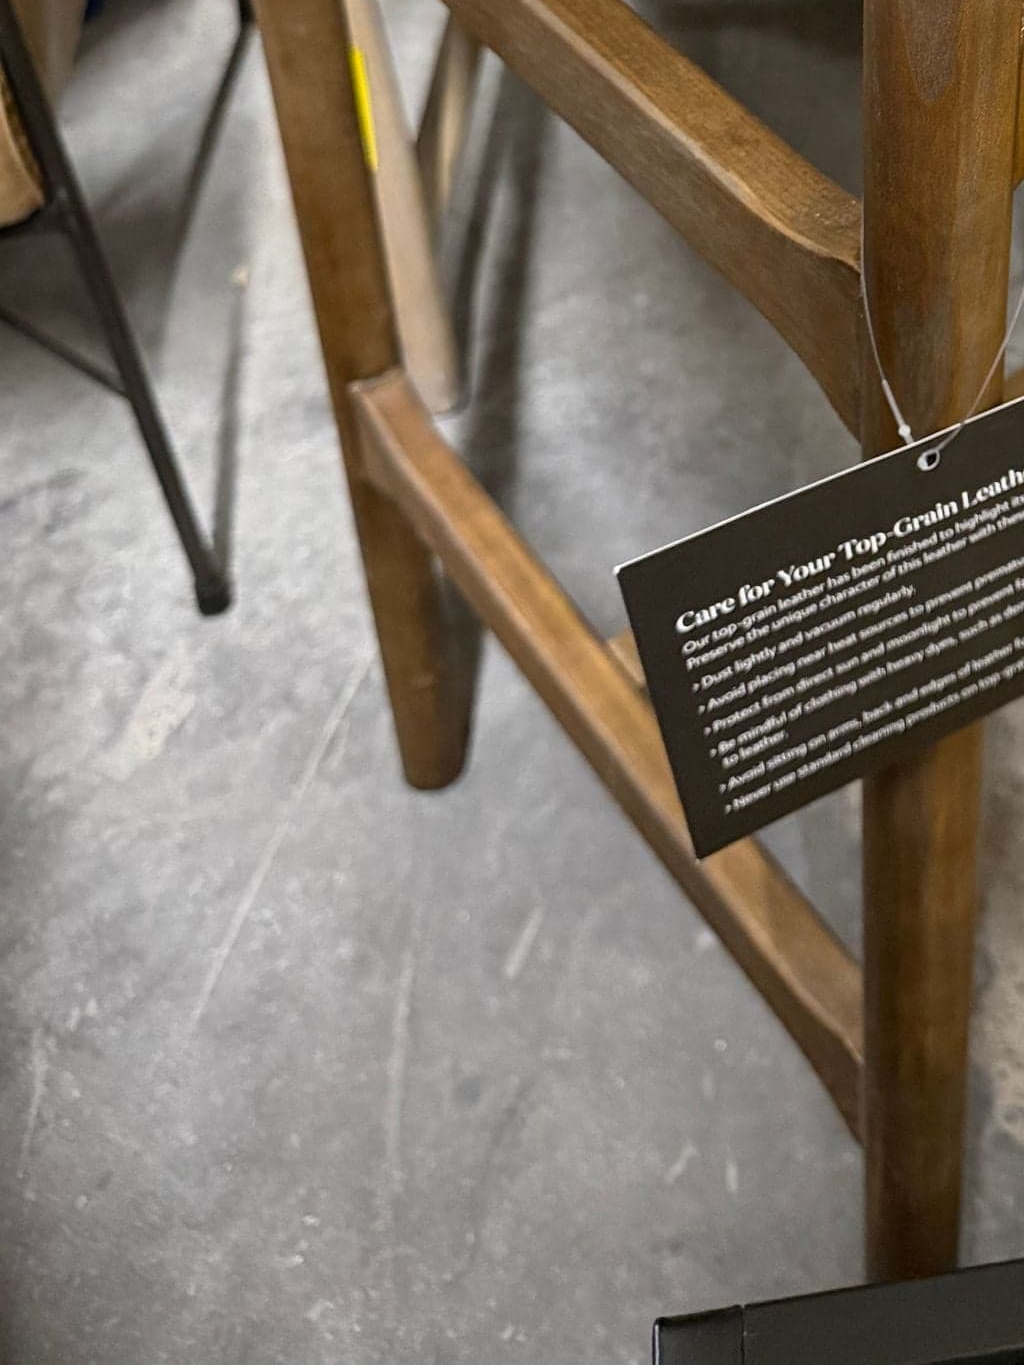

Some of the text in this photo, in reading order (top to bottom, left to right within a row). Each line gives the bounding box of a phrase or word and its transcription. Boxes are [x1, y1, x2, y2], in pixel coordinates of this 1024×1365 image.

[674, 596, 736, 633] Care
[737, 577, 776, 607] for
[776, 551, 836, 587] Your
[836, 500, 959, 560] Top-Grain
[681, 633, 710, 654] Our
[711, 604, 777, 641] top-grain
[776, 582, 825, 611] leather
[825, 571, 851, 589] has
[850, 556, 886, 579] been
[885, 531, 938, 563] finished
[937, 527, 955, 541] to
[953, 500, 1010, 533] highlight
[685, 635, 745, 670] Preserve
[744, 623, 770, 642] the
[770, 602, 818, 630] unique
[817, 574, 881, 610] character
[881, 564, 896, 582] of
[896, 556, 923, 575] this
[921, 535, 968, 564] leather
[967, 522, 997, 543] with
[700, 583, 918, 689] Dust lightly and vacuum regularly.
[706, 681, 747, 711] Avoid
[746, 660, 796, 693] placing
[795, 646, 826, 668] near
[826, 631, 858, 653] heat
[857, 610, 909, 640] sources
[907, 603, 925, 617] to
[924, 580, 973, 613] prevent
[711, 700, 761, 732] Protect
[760, 685, 795, 708] from
[794, 666, 834, 692] direct
[834, 655, 860, 674] sun
[859, 640, 885, 663] and
[885, 613, 951, 650] moonlight
[950, 606, 968, 621] to
[966, 582, 1014, 616] prevent
